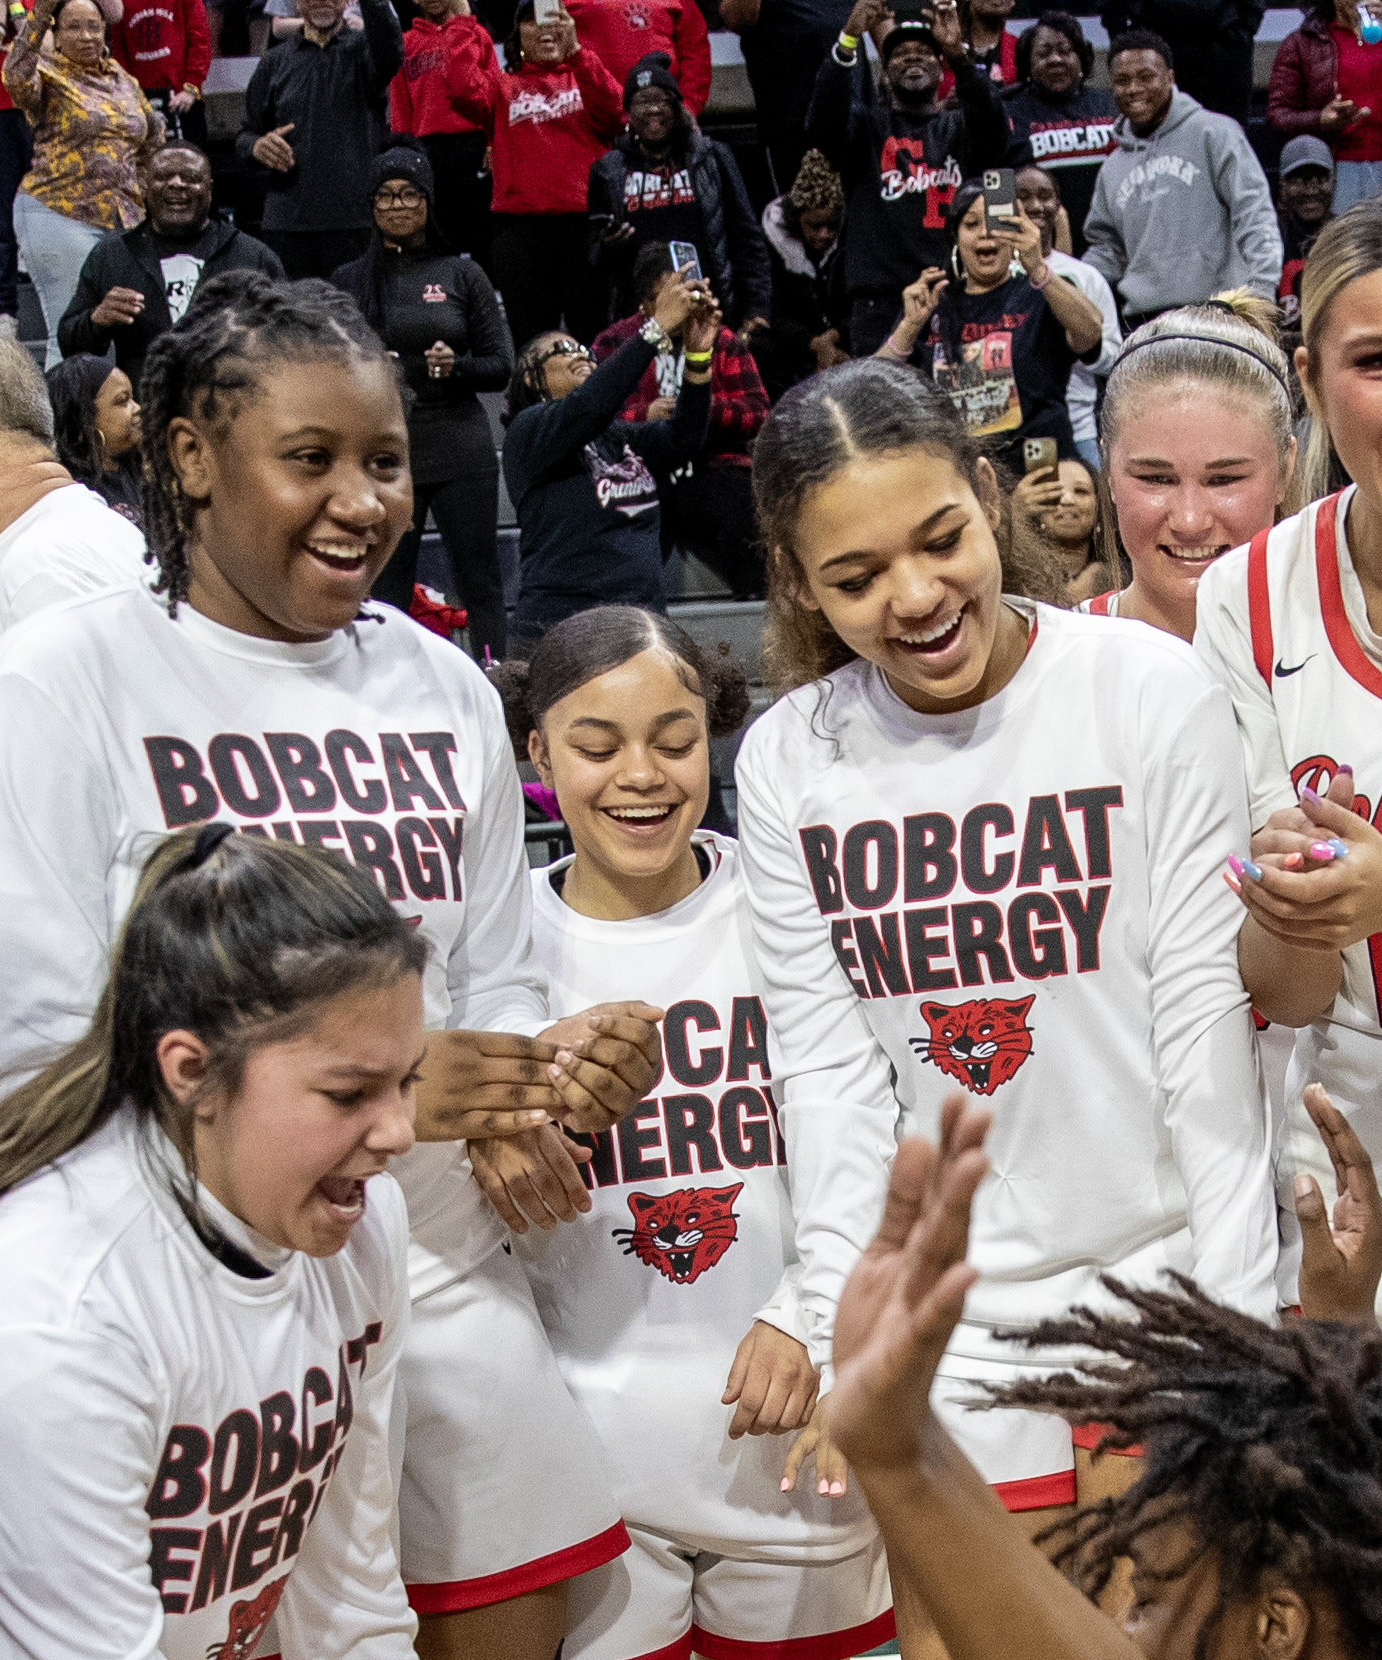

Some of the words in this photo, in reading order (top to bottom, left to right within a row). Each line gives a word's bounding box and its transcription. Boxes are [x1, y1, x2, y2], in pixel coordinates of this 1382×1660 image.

[881, 154, 963, 201] Bobcats
[1028, 124, 1114, 158] BOBCAT
[142, 729, 468, 830] BOBCAT
[799, 785, 1124, 916] BOBCAT
[830, 884, 1112, 999] ENERGY
[145, 1321, 383, 1521] BOBCAT
